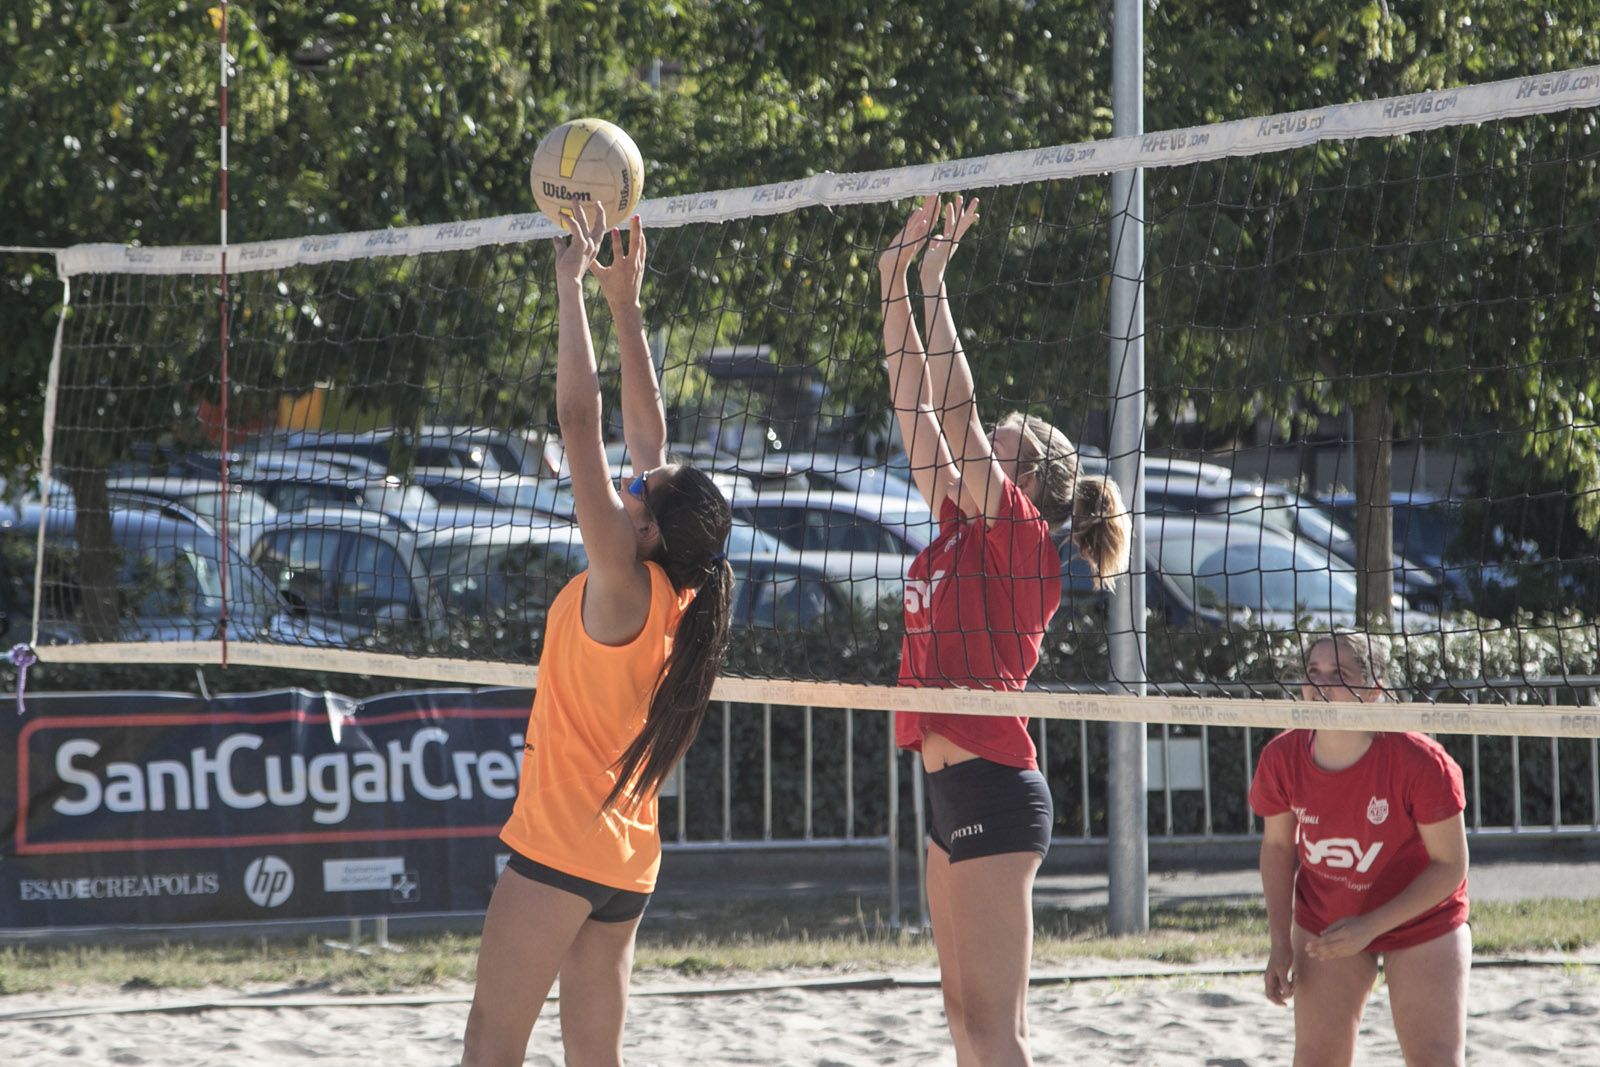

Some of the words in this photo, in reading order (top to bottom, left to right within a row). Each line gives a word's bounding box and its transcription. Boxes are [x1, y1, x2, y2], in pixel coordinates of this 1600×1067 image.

[543, 181, 591, 201] Wilson
[618, 168, 630, 211] Wilson
[20, 873, 220, 900] ESADECREAPOLIS
[248, 856, 290, 907] hp
